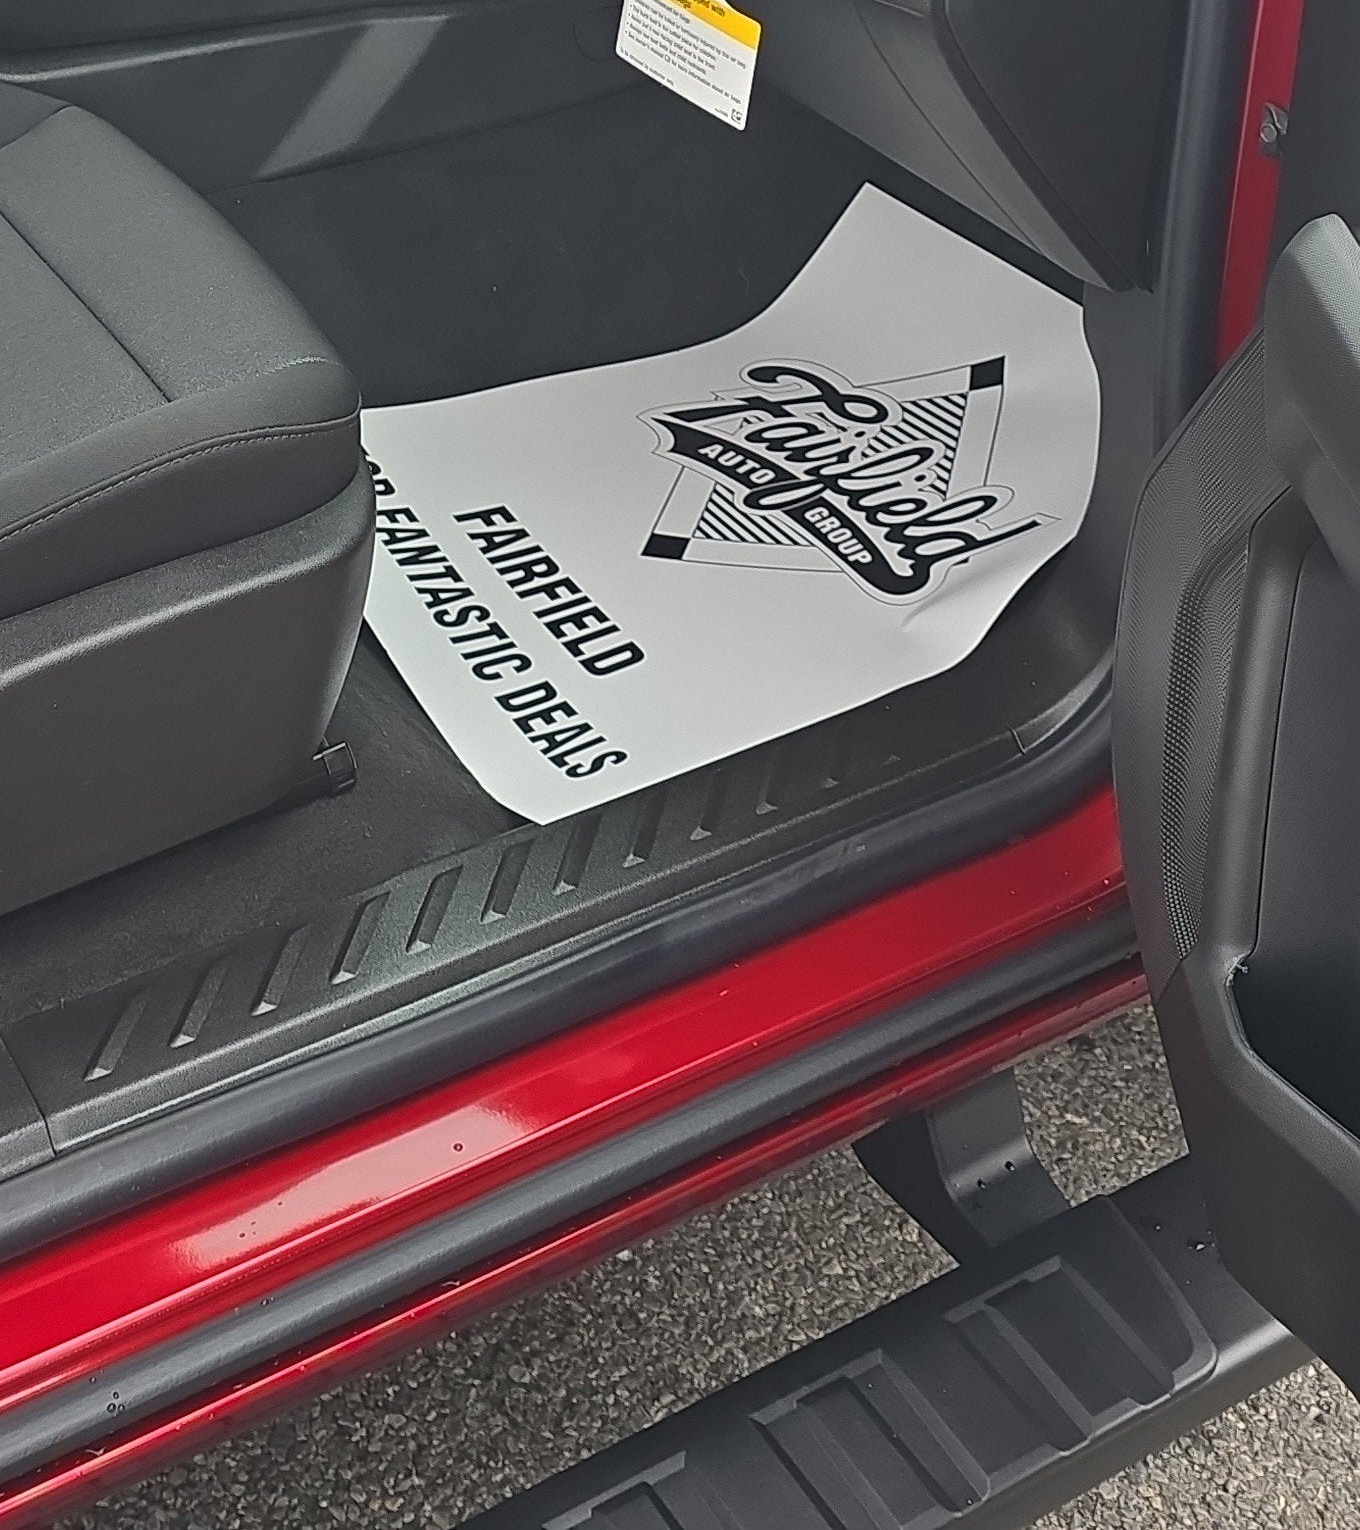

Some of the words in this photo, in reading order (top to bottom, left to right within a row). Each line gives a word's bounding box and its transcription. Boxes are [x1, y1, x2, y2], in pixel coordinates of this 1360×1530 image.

[662, 366, 1041, 570] Fairfield
[697, 441, 776, 485] AUTO
[803, 505, 875, 567] GROUP
[376, 506, 533, 682] FANTASTIC
[494, 680, 629, 779] DEALS
[452, 505, 645, 677] FAIRFIELD
